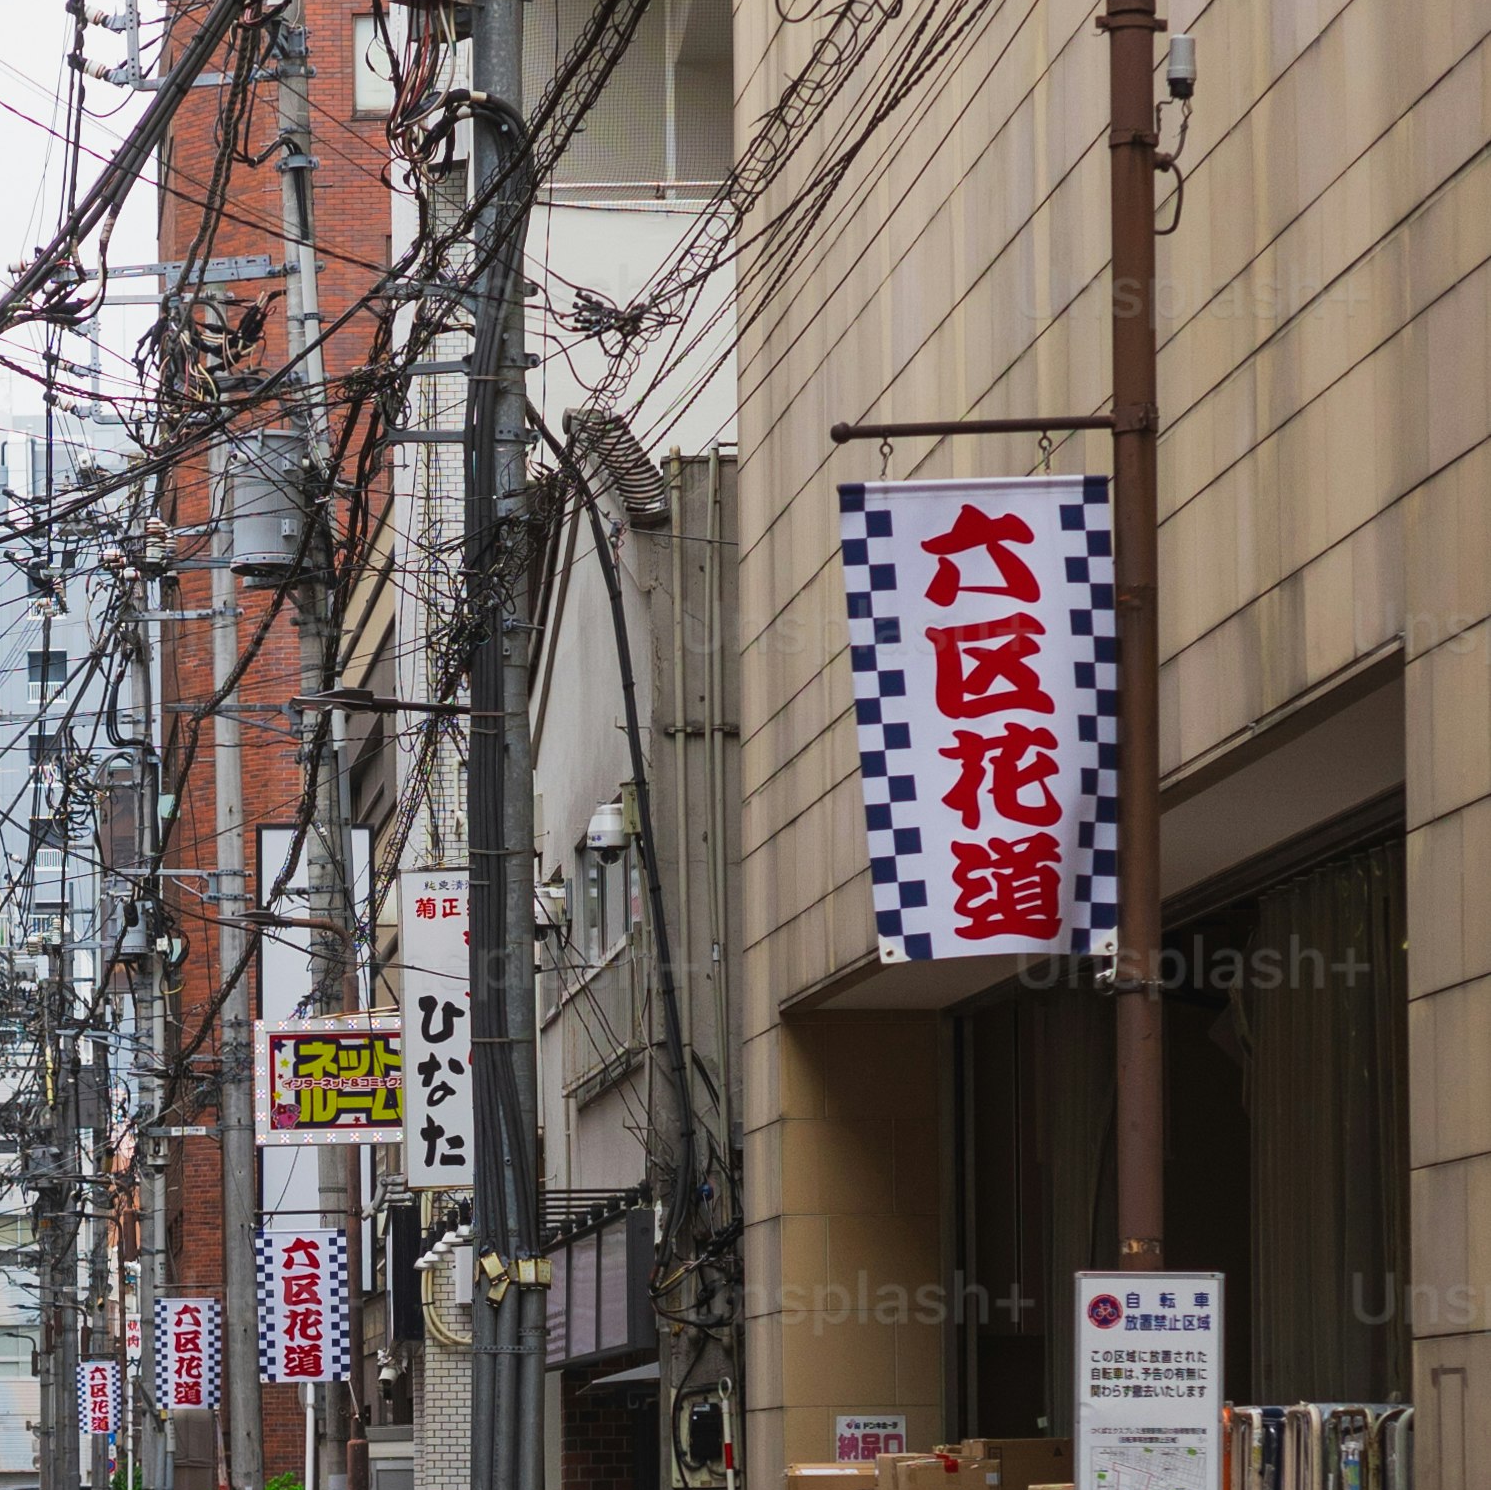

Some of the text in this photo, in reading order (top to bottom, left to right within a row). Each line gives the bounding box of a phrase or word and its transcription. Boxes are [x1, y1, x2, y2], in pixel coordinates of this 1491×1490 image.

[921, 503, 1063, 941] 六区花道
[415, 897, 470, 920] 菊正
[417, 995, 467, 1168] ひなた
[281, 1237, 325, 1377] 六区花道
[1126, 1292, 1210, 1309] 自転車
[1124, 1314, 1211, 1331] 放置禁止区域
[173, 1304, 204, 1406] 六区花道
[1091, 1350, 1208, 1364] この区域に放置された
[1091, 1368, 1208, 1381] 自転車は、予告の有無に
[89, 1365, 110, 1434] 六区花道
[1090, 1384, 1208, 1399] 関わらず撤去いたします
[838, 1433, 904, 1462] 納品口
